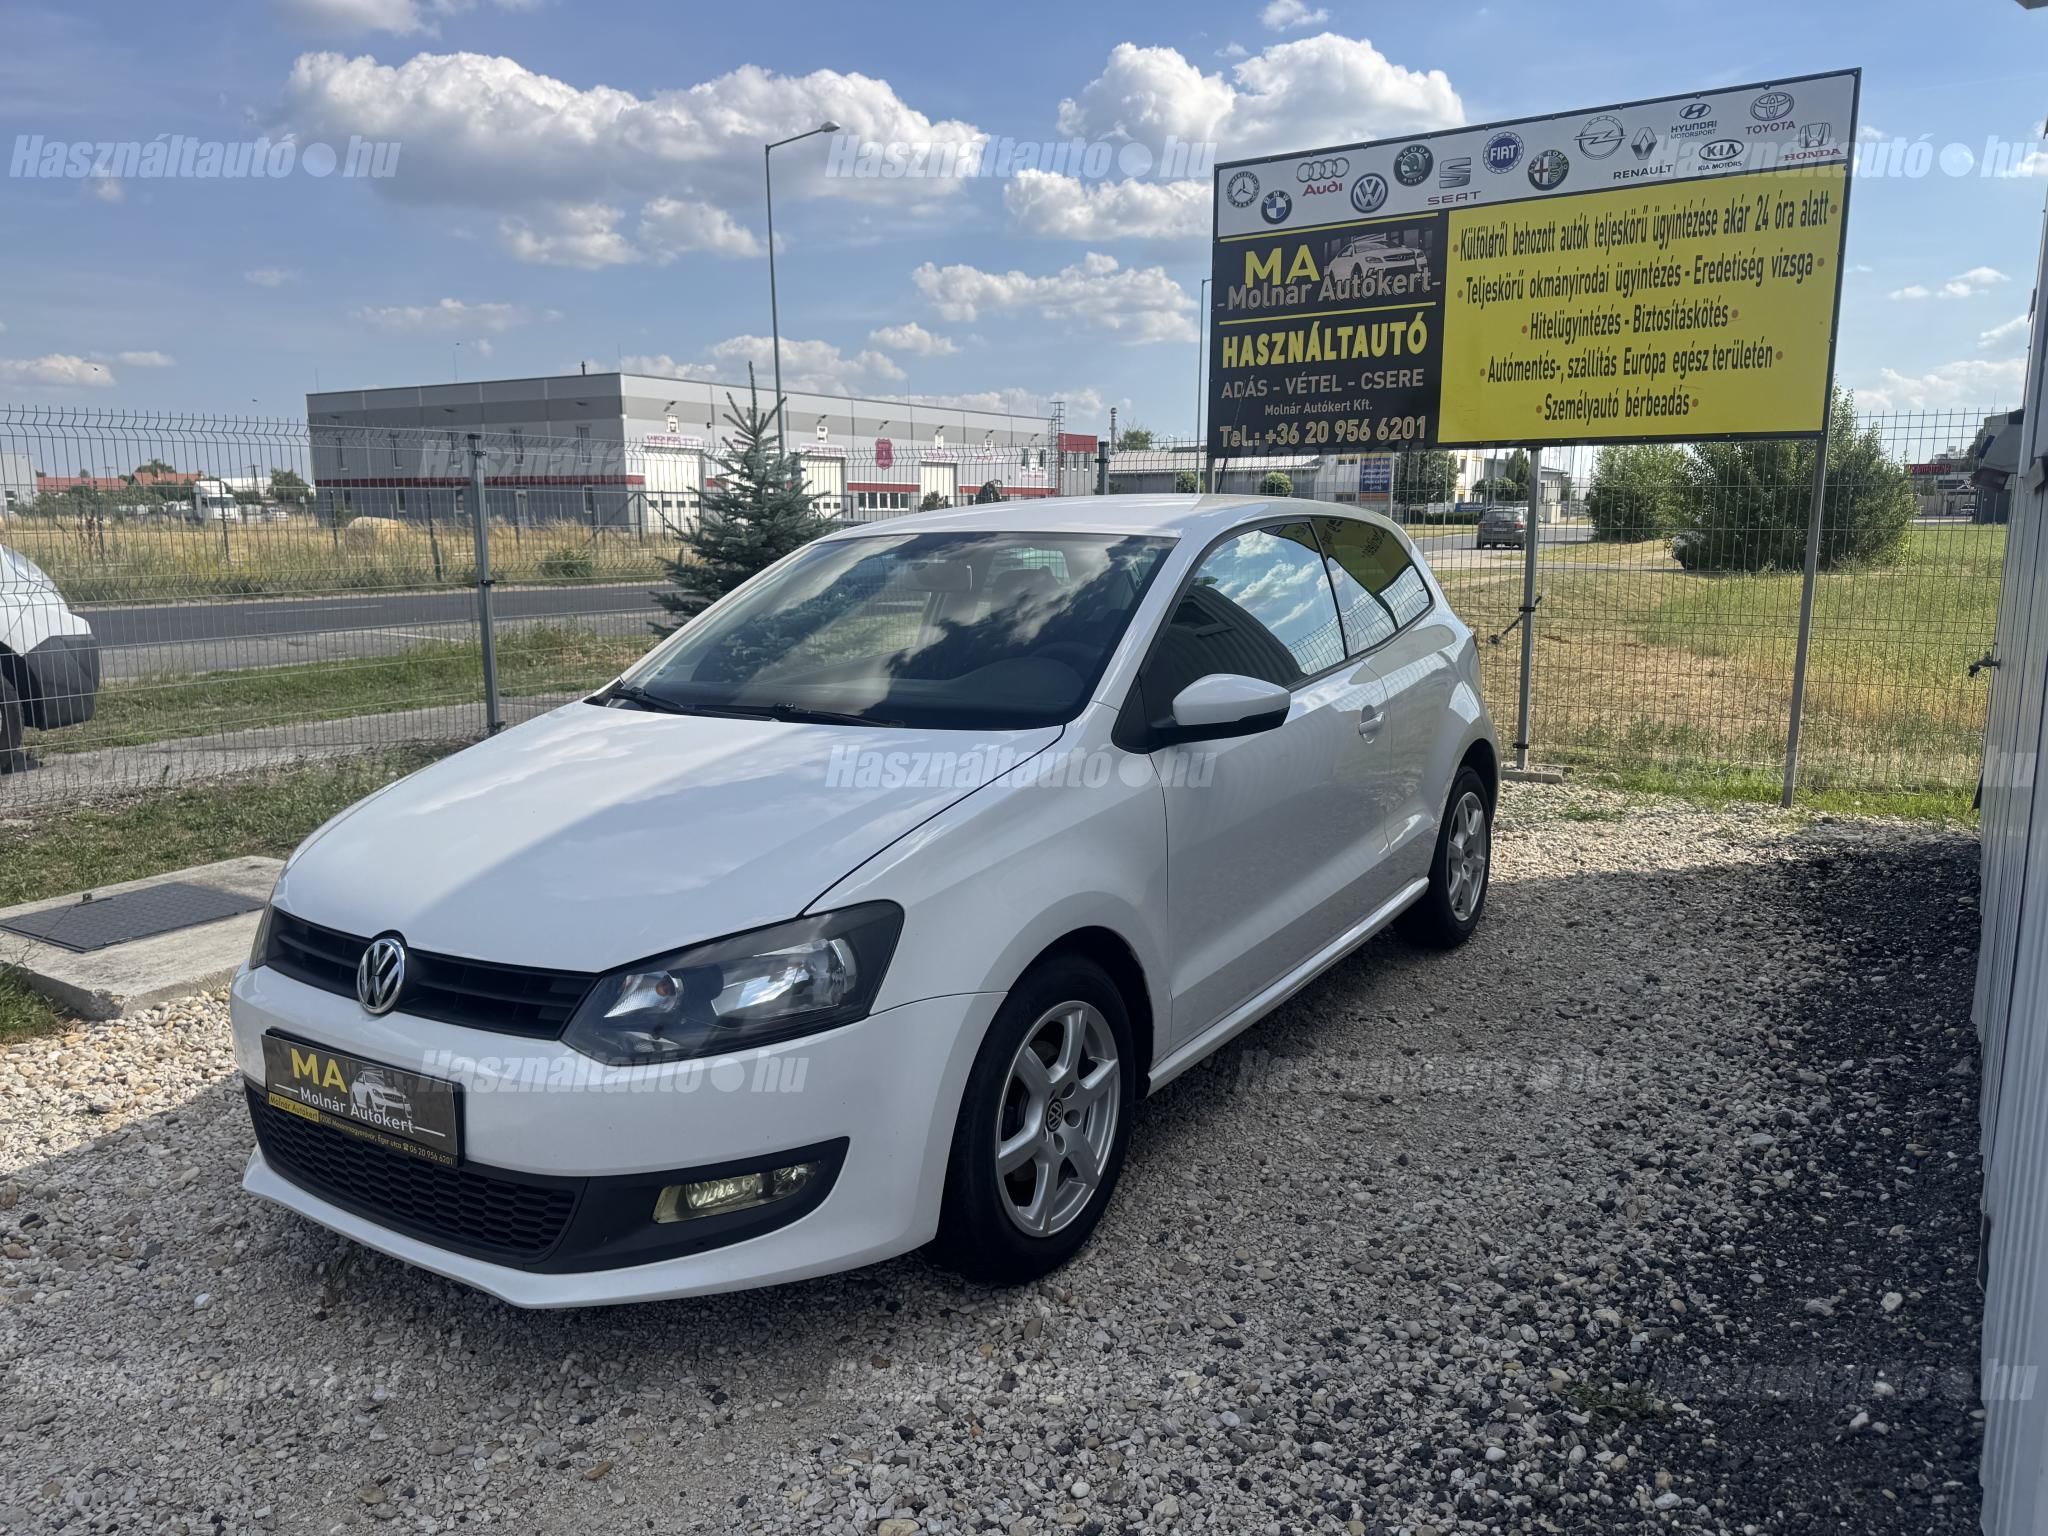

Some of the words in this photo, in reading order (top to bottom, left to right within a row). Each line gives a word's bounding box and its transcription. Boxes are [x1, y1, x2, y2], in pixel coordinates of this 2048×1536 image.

[1670, 120, 1717, 134] HYUNDAI
[1670, 129, 1717, 140] MOTORSPORT
[1746, 121, 1796, 135] TOYOTA
[1489, 144, 1516, 162] FIAT
[1706, 144, 1737, 158] KIA
[1783, 147, 1842, 161] HONDA
[1613, 163, 1673, 180] RENAULT
[1697, 163, 1711, 171] KIA
[1712, 160, 1743, 170] MOTORS
[1302, 181, 1344, 197] Audi
[1427, 190, 1482, 206] SEAT
[1460, 220, 1508, 262] Külföldről
[1512, 220, 1556, 256] behozott
[1560, 211, 1589, 251] autók
[1594, 204, 1649, 255] teljeskörű
[1652, 197, 1718, 250] ügyintézése
[1723, 193, 1750, 234] akár
[1754, 193, 1770, 231] 24
[1774, 189, 1795, 230] óra
[1800, 188, 1829, 227] alatt
[1244, 244, 1321, 288] MA
[1466, 269, 1525, 310] Teljeskörű
[1529, 264, 1609, 303] okmányirodai
[1615, 254, 1681, 299] ügyintézés
[1693, 246, 1764, 287] Eredetiség
[1771, 247, 1814, 285] vizsga
[1530, 304, 1621, 345] Hitelügyintézés
[1632, 295, 1729, 333] Biztosításkötés
[1222, 311, 1428, 369] HASZNÁLTAUTÓ
[1567, 345, 1617, 378] szállítás
[1623, 343, 1666, 381] Európa
[1672, 340, 1709, 380] egész
[1712, 335, 1773, 372] területén
[1221, 373, 1268, 399] ADÁS
[1285, 372, 1342, 395] VÉTEL
[1360, 368, 1425, 390] CSERE
[1264, 401, 1301, 416] Molnár
[1303, 400, 1350, 414] Autókert
[1353, 399, 1373, 411] Kft.
[1544, 387, 1619, 426] Személyautó
[1625, 384, 1690, 417] bérbeadás
[1219, 424, 1260, 448] Tel.:
[1265, 422, 1300, 445] +36
[1304, 420, 1329, 444] 20
[1334, 417, 1371, 443] 956
[1376, 415, 1426, 442] 6201
[290, 1047, 348, 1094] MA
[300, 1086, 347, 1113] Molnár
